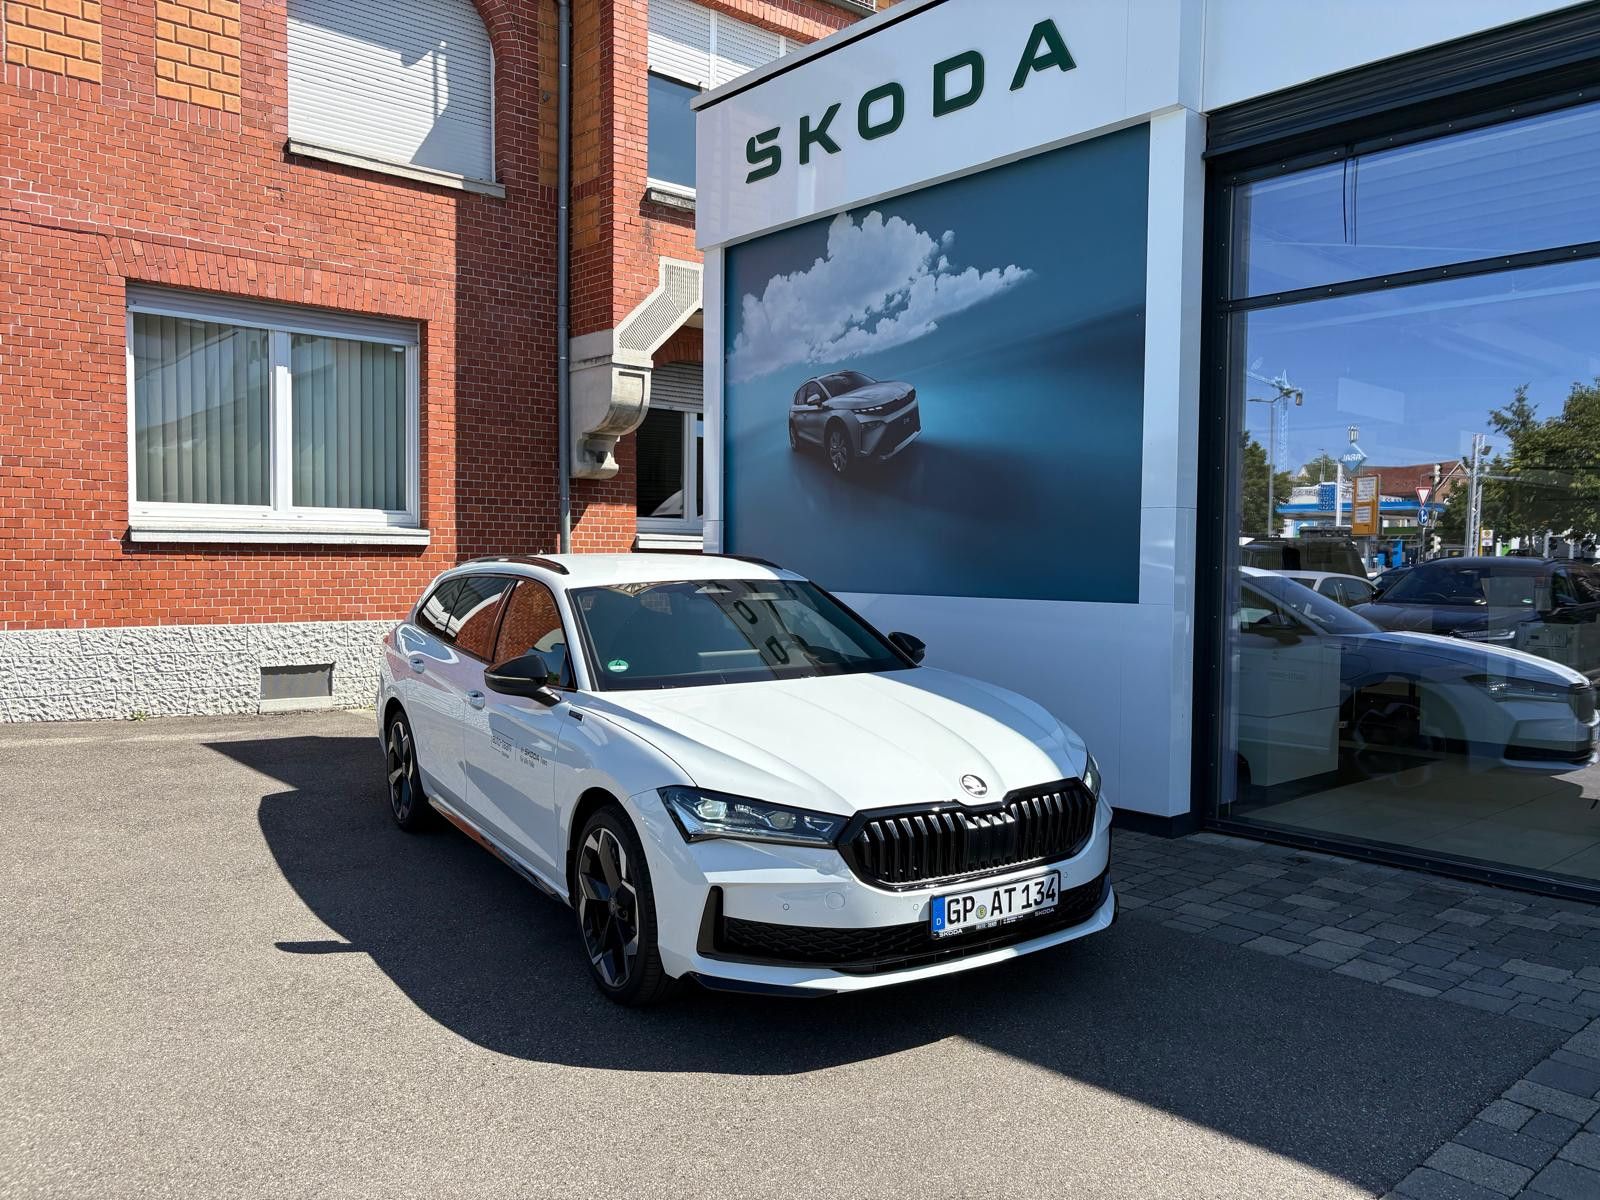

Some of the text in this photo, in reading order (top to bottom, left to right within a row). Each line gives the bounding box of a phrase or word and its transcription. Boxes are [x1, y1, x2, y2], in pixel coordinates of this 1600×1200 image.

[936, 877, 1056, 926] D GP AT 134
